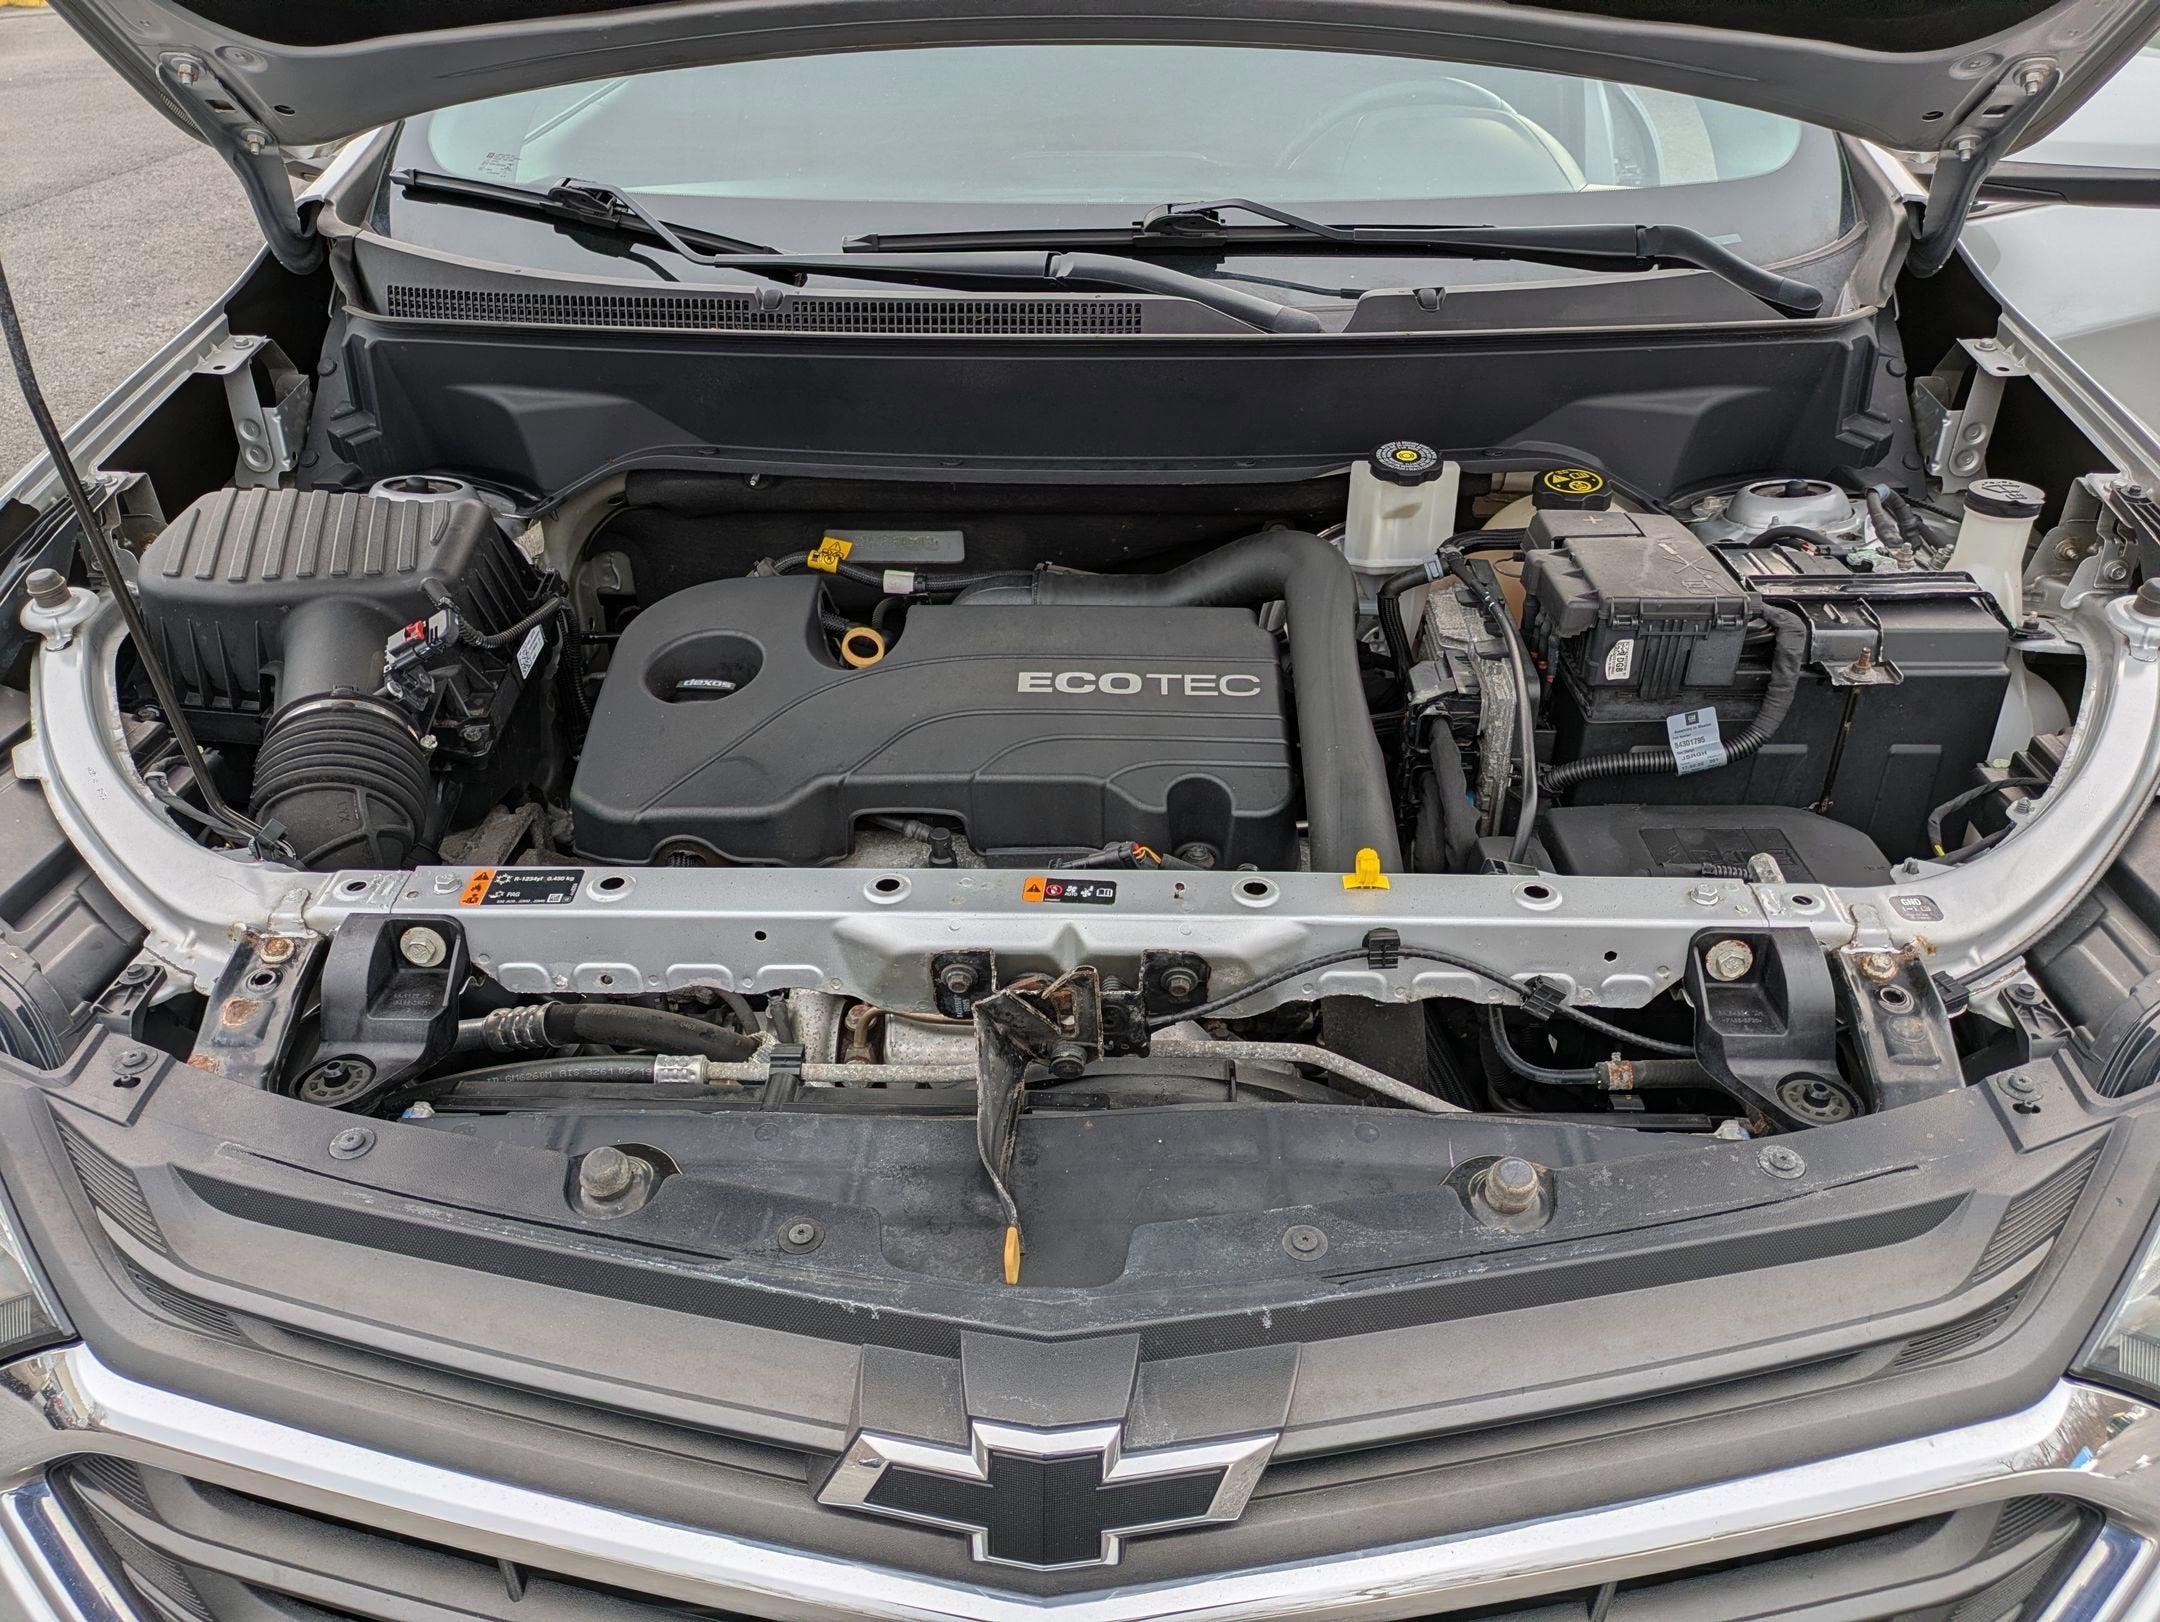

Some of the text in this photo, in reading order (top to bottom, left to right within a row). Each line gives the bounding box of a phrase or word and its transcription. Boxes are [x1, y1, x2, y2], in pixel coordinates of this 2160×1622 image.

[683, 678, 732, 688] dexos
[1017, 671, 1262, 697] ECOTEC
[1900, 898, 1921, 906] GND
